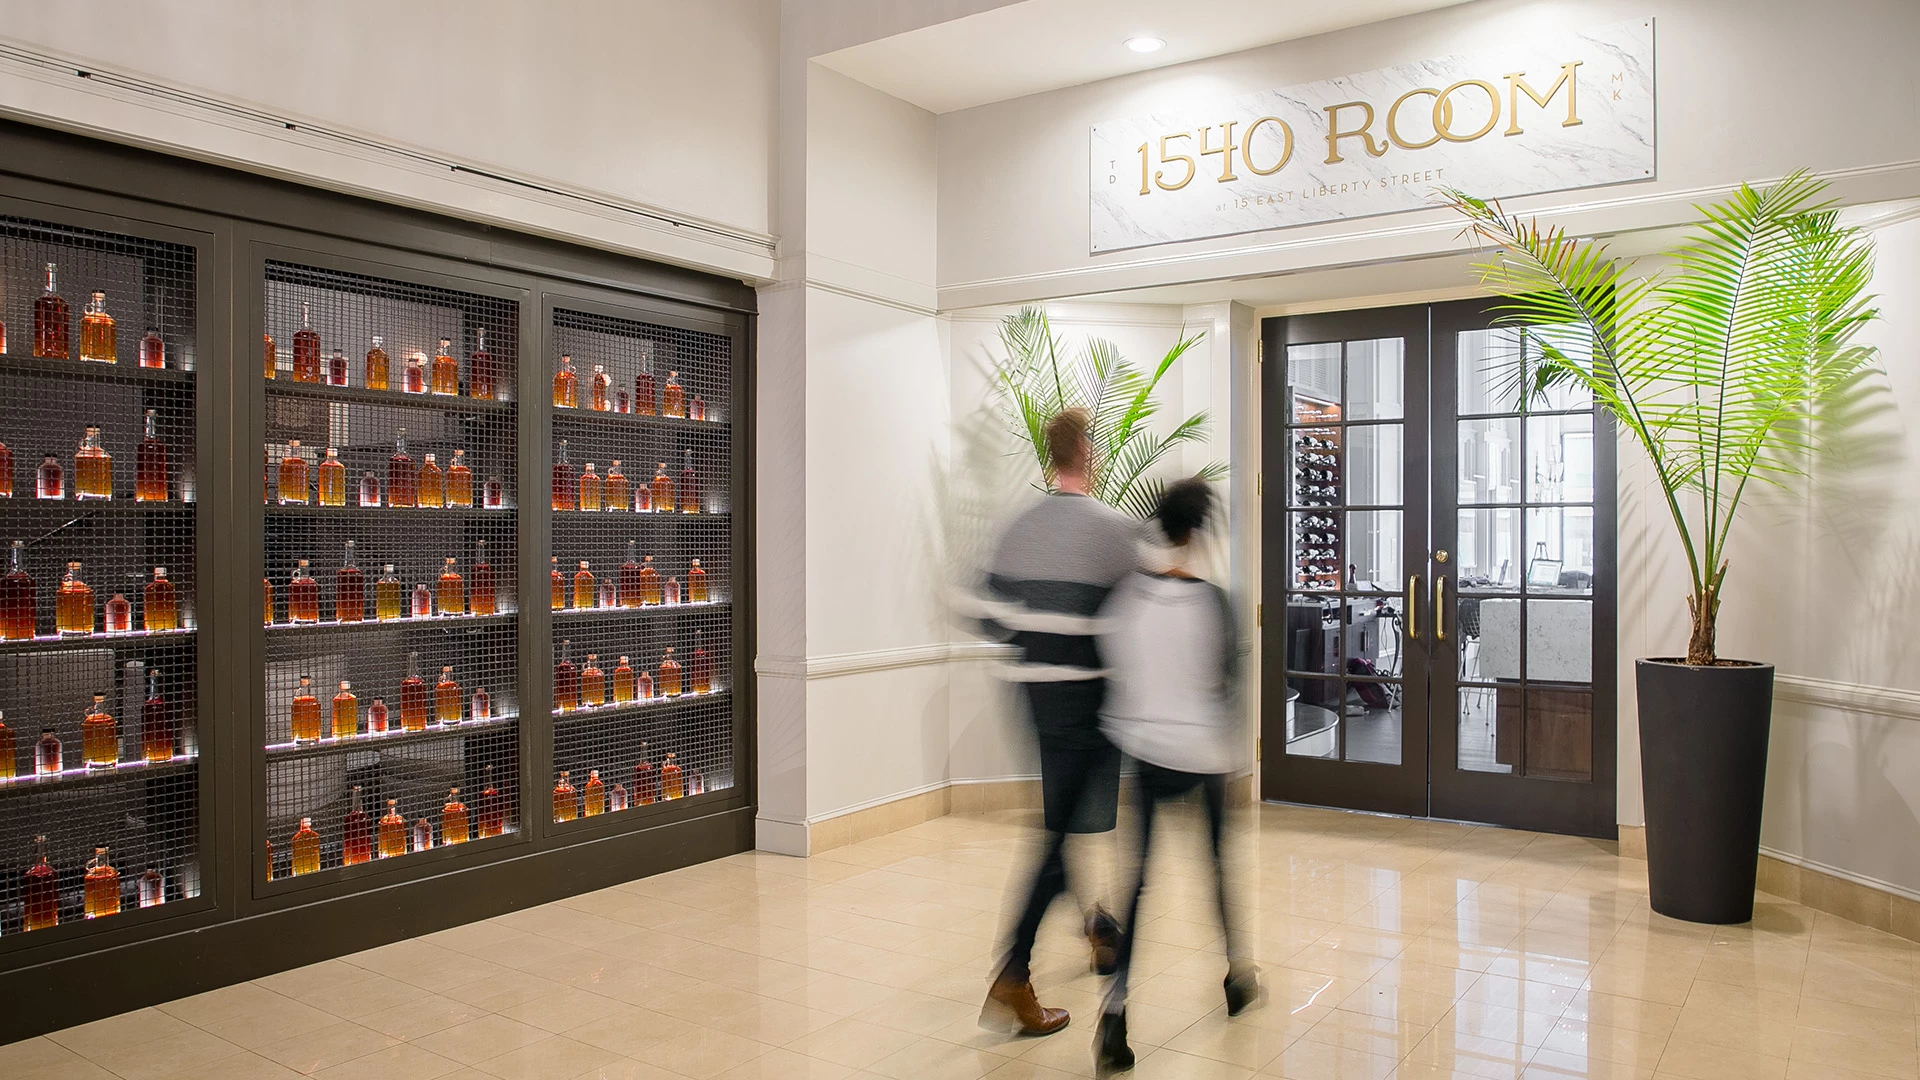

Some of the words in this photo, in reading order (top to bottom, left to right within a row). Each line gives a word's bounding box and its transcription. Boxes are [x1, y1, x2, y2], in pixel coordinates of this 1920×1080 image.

[1137, 116, 1294, 195] 1540
[1323, 60, 1584, 165] ROOM
[1215, 203, 1226, 211] at
[1234, 198, 1248, 208] 15
[1256, 191, 1293, 206] EAST
[1302, 180, 1371, 199] LIBERTY
[1380, 168, 1444, 188] STREET
